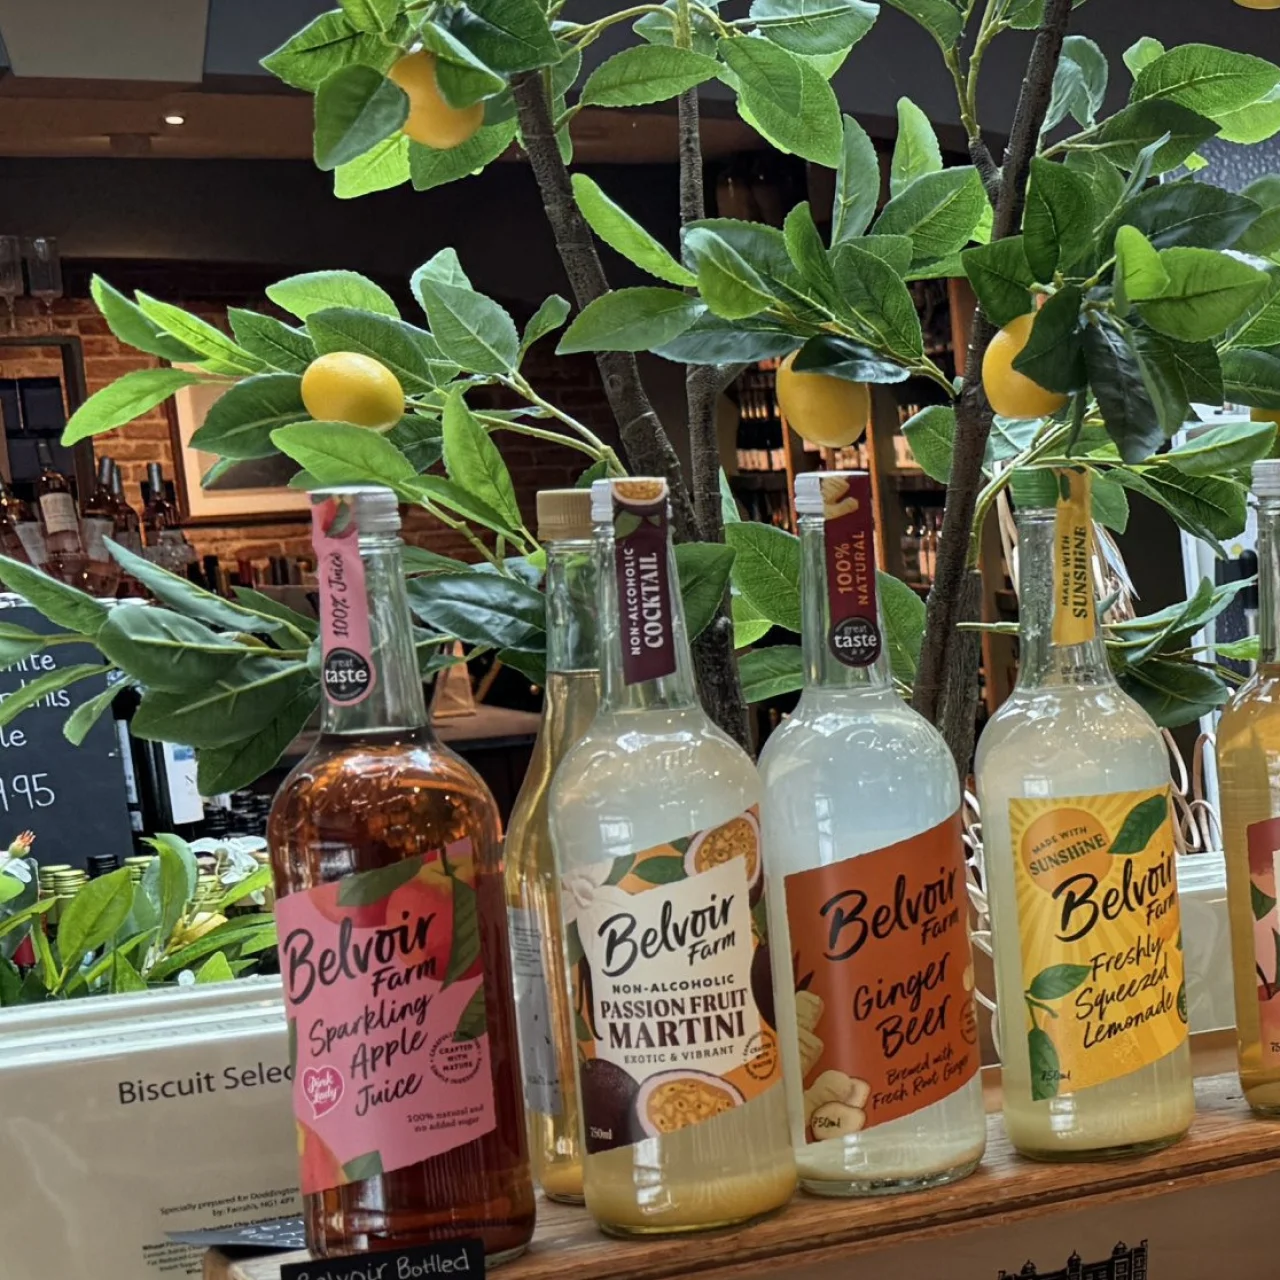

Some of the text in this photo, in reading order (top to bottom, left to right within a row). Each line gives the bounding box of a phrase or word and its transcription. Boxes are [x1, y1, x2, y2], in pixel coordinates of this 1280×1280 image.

[834, 543, 854, 594] 100%
[852, 531, 869, 605] NATURAL
[1062, 572, 1070, 606] MADE
[328, 552, 349, 638] 100% Juice
[624, 548, 641, 656] NON-ALCOHOLIC
[639, 552, 664, 648] COCKTAIL
[834, 635, 878, 648] taste
[325, 668, 368, 683] taste
[1032, 836, 1059, 853] MADE
[819, 865, 958, 962] Belvoir
[1051, 851, 1173, 942] Belvoir
[283, 910, 436, 1005] Belvoir
[598, 894, 735, 977] Belvoir
[688, 931, 736, 966] Farm
[1090, 934, 1165, 982] Freshly
[372, 957, 436, 997] Farm
[612, 974, 735, 995] NON-ALCOHOLIC
[853, 952, 950, 1022] Ginger
[1075, 952, 1169, 1021] Squeezed
[309, 992, 435, 1057] Sparkling
[601, 988, 748, 1018] PASSION FRUIT
[875, 994, 952, 1060] Beer
[1083, 986, 1174, 1049] Lemonade
[351, 1028, 428, 1079] Apple
[609, 1010, 745, 1049] MARTINI
[624, 1045, 735, 1064] EXOTIC & VIBRANT
[118, 1062, 293, 1104] Biscuit Selec
[355, 1072, 423, 1116] Juice
[872, 1083, 909, 1110] Fresh
[812, 1116, 841, 1129] 750ml
[396, 1248, 471, 1280] Bottled
